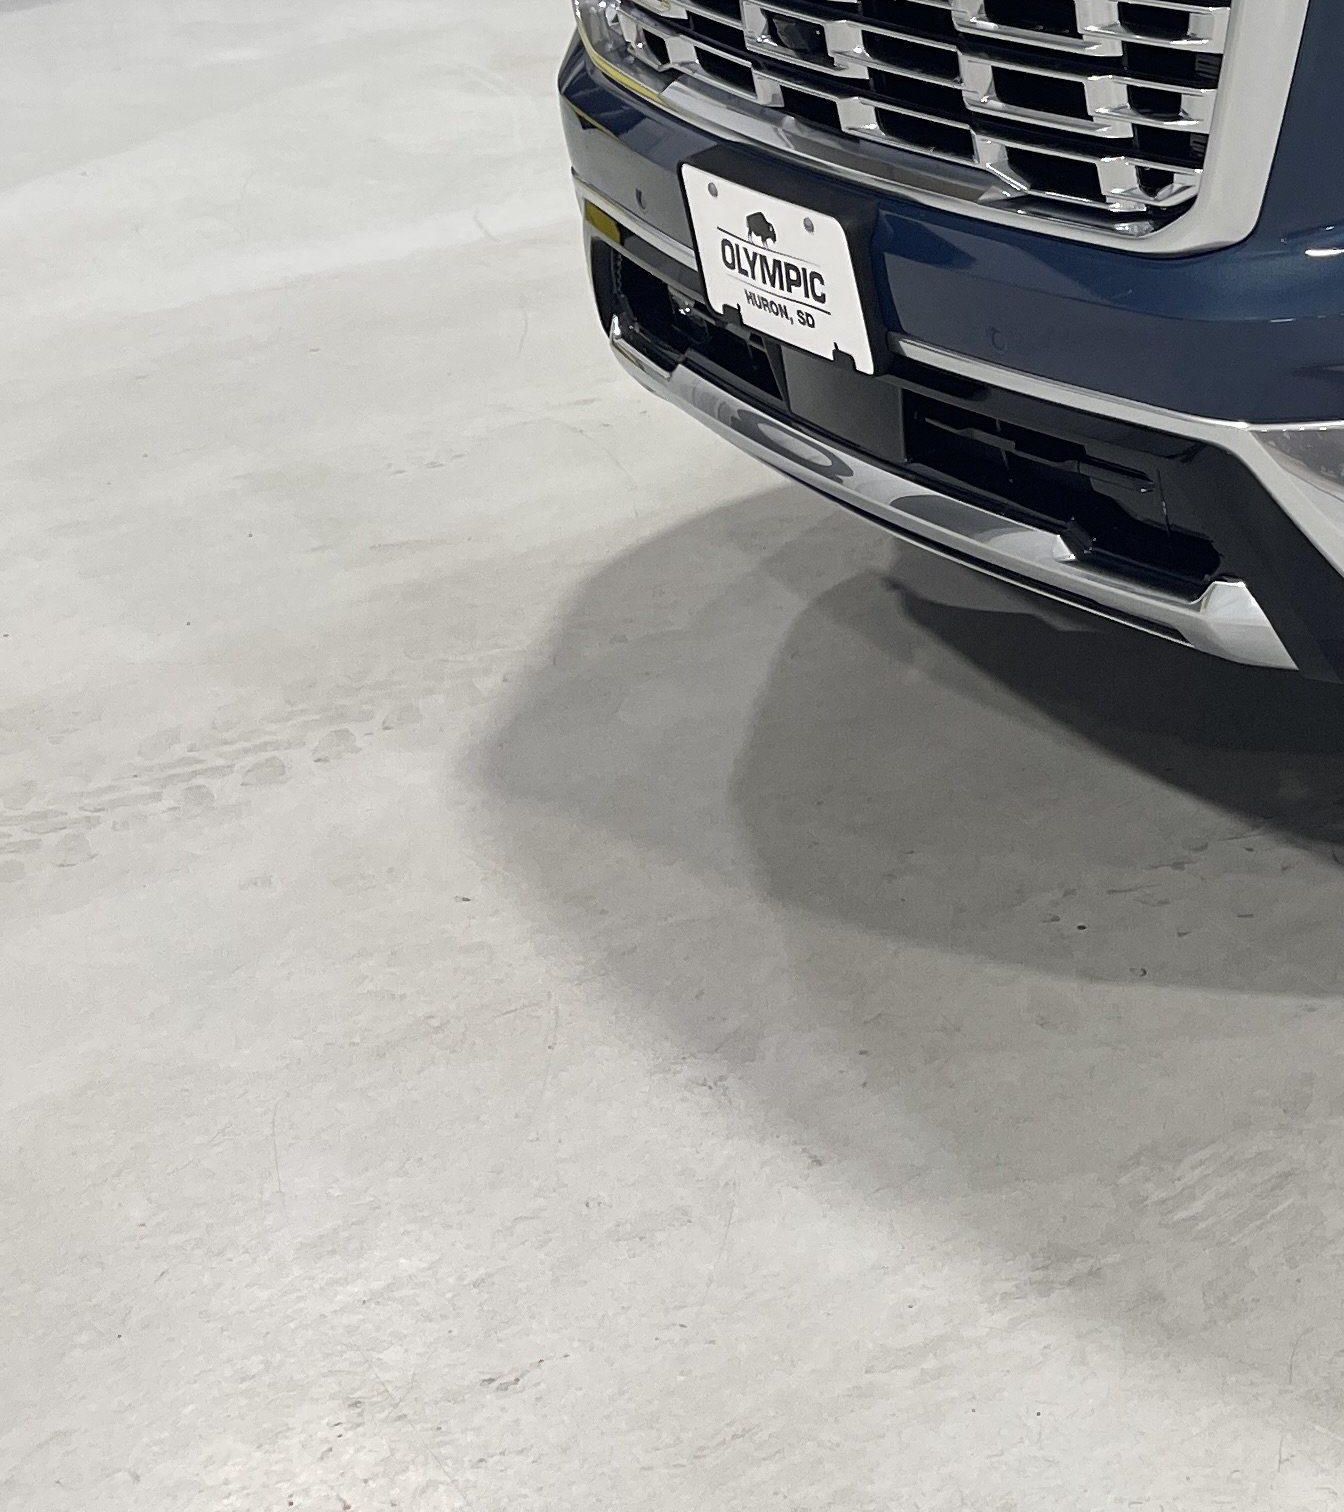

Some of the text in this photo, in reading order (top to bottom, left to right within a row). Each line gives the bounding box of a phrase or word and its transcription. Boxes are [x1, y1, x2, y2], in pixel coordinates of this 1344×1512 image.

[720, 238, 827, 304] OLYMPIC
[744, 288, 816, 329] HURON, SD
